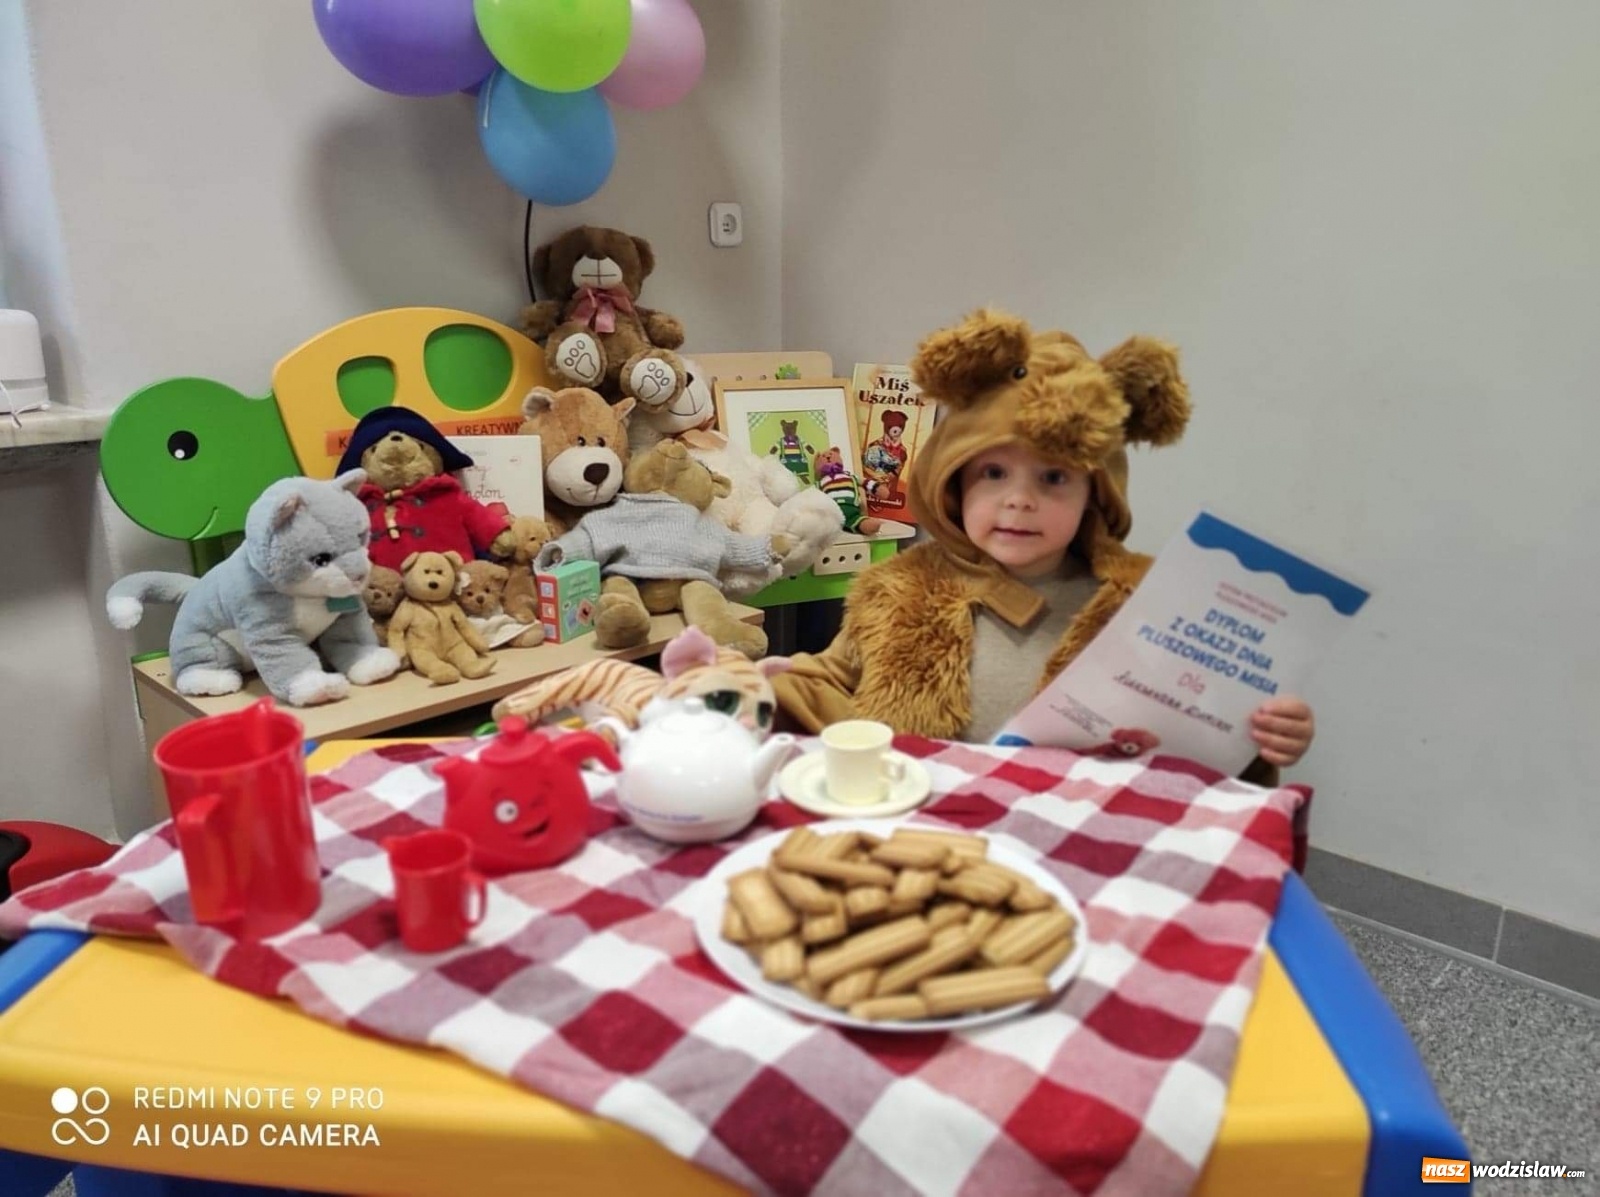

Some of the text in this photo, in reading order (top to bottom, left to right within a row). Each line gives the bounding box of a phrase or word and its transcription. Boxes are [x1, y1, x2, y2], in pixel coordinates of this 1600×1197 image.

[875, 376, 909, 392] Miś
[1169, 616, 1273, 671] Z OKAZJI DNIA
[1204, 608, 1266, 644] DYPLOM
[1138, 624, 1279, 696] PLUSZOWEGO MISIA
[1177, 671, 1206, 695] Dla
